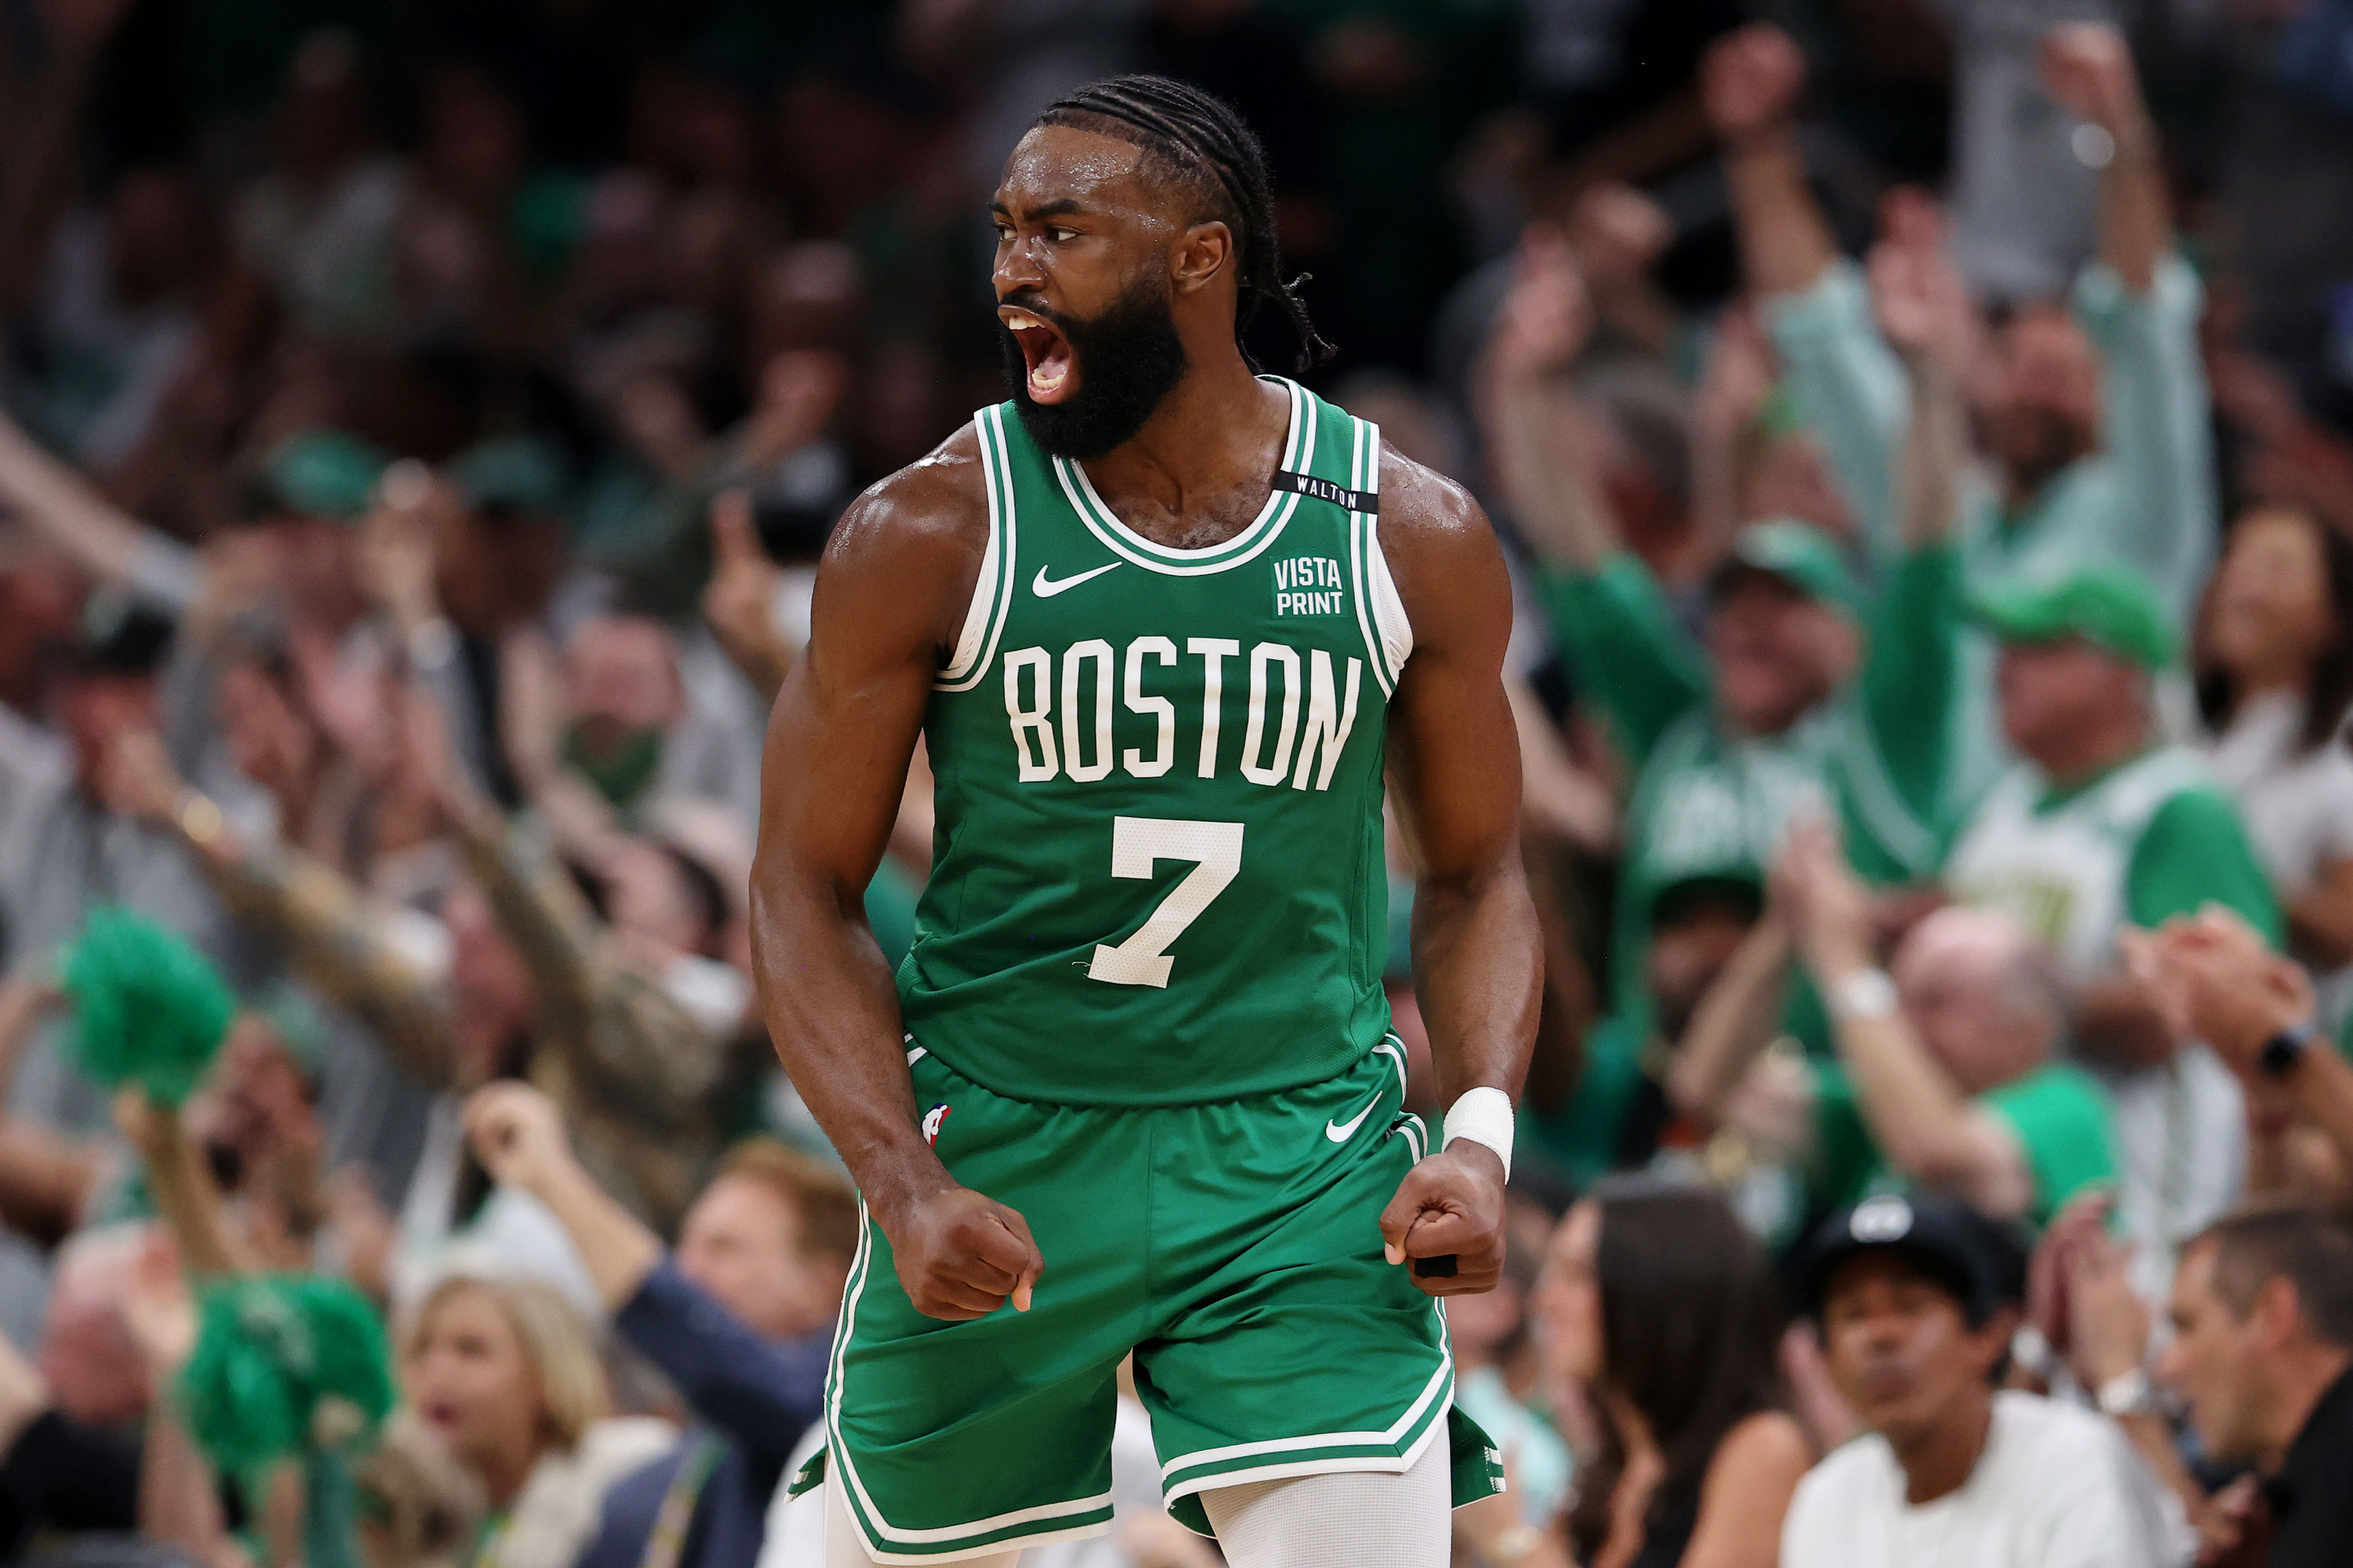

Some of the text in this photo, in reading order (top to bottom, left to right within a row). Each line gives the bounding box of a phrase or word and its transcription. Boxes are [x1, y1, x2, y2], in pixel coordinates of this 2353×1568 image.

[1297, 476, 1357, 508] WALTON
[1274, 557, 1342, 591] VISTA
[1277, 592, 1343, 616] PRINT
[1004, 636, 1362, 791] BOSTON
[1088, 816, 1245, 989] 7
